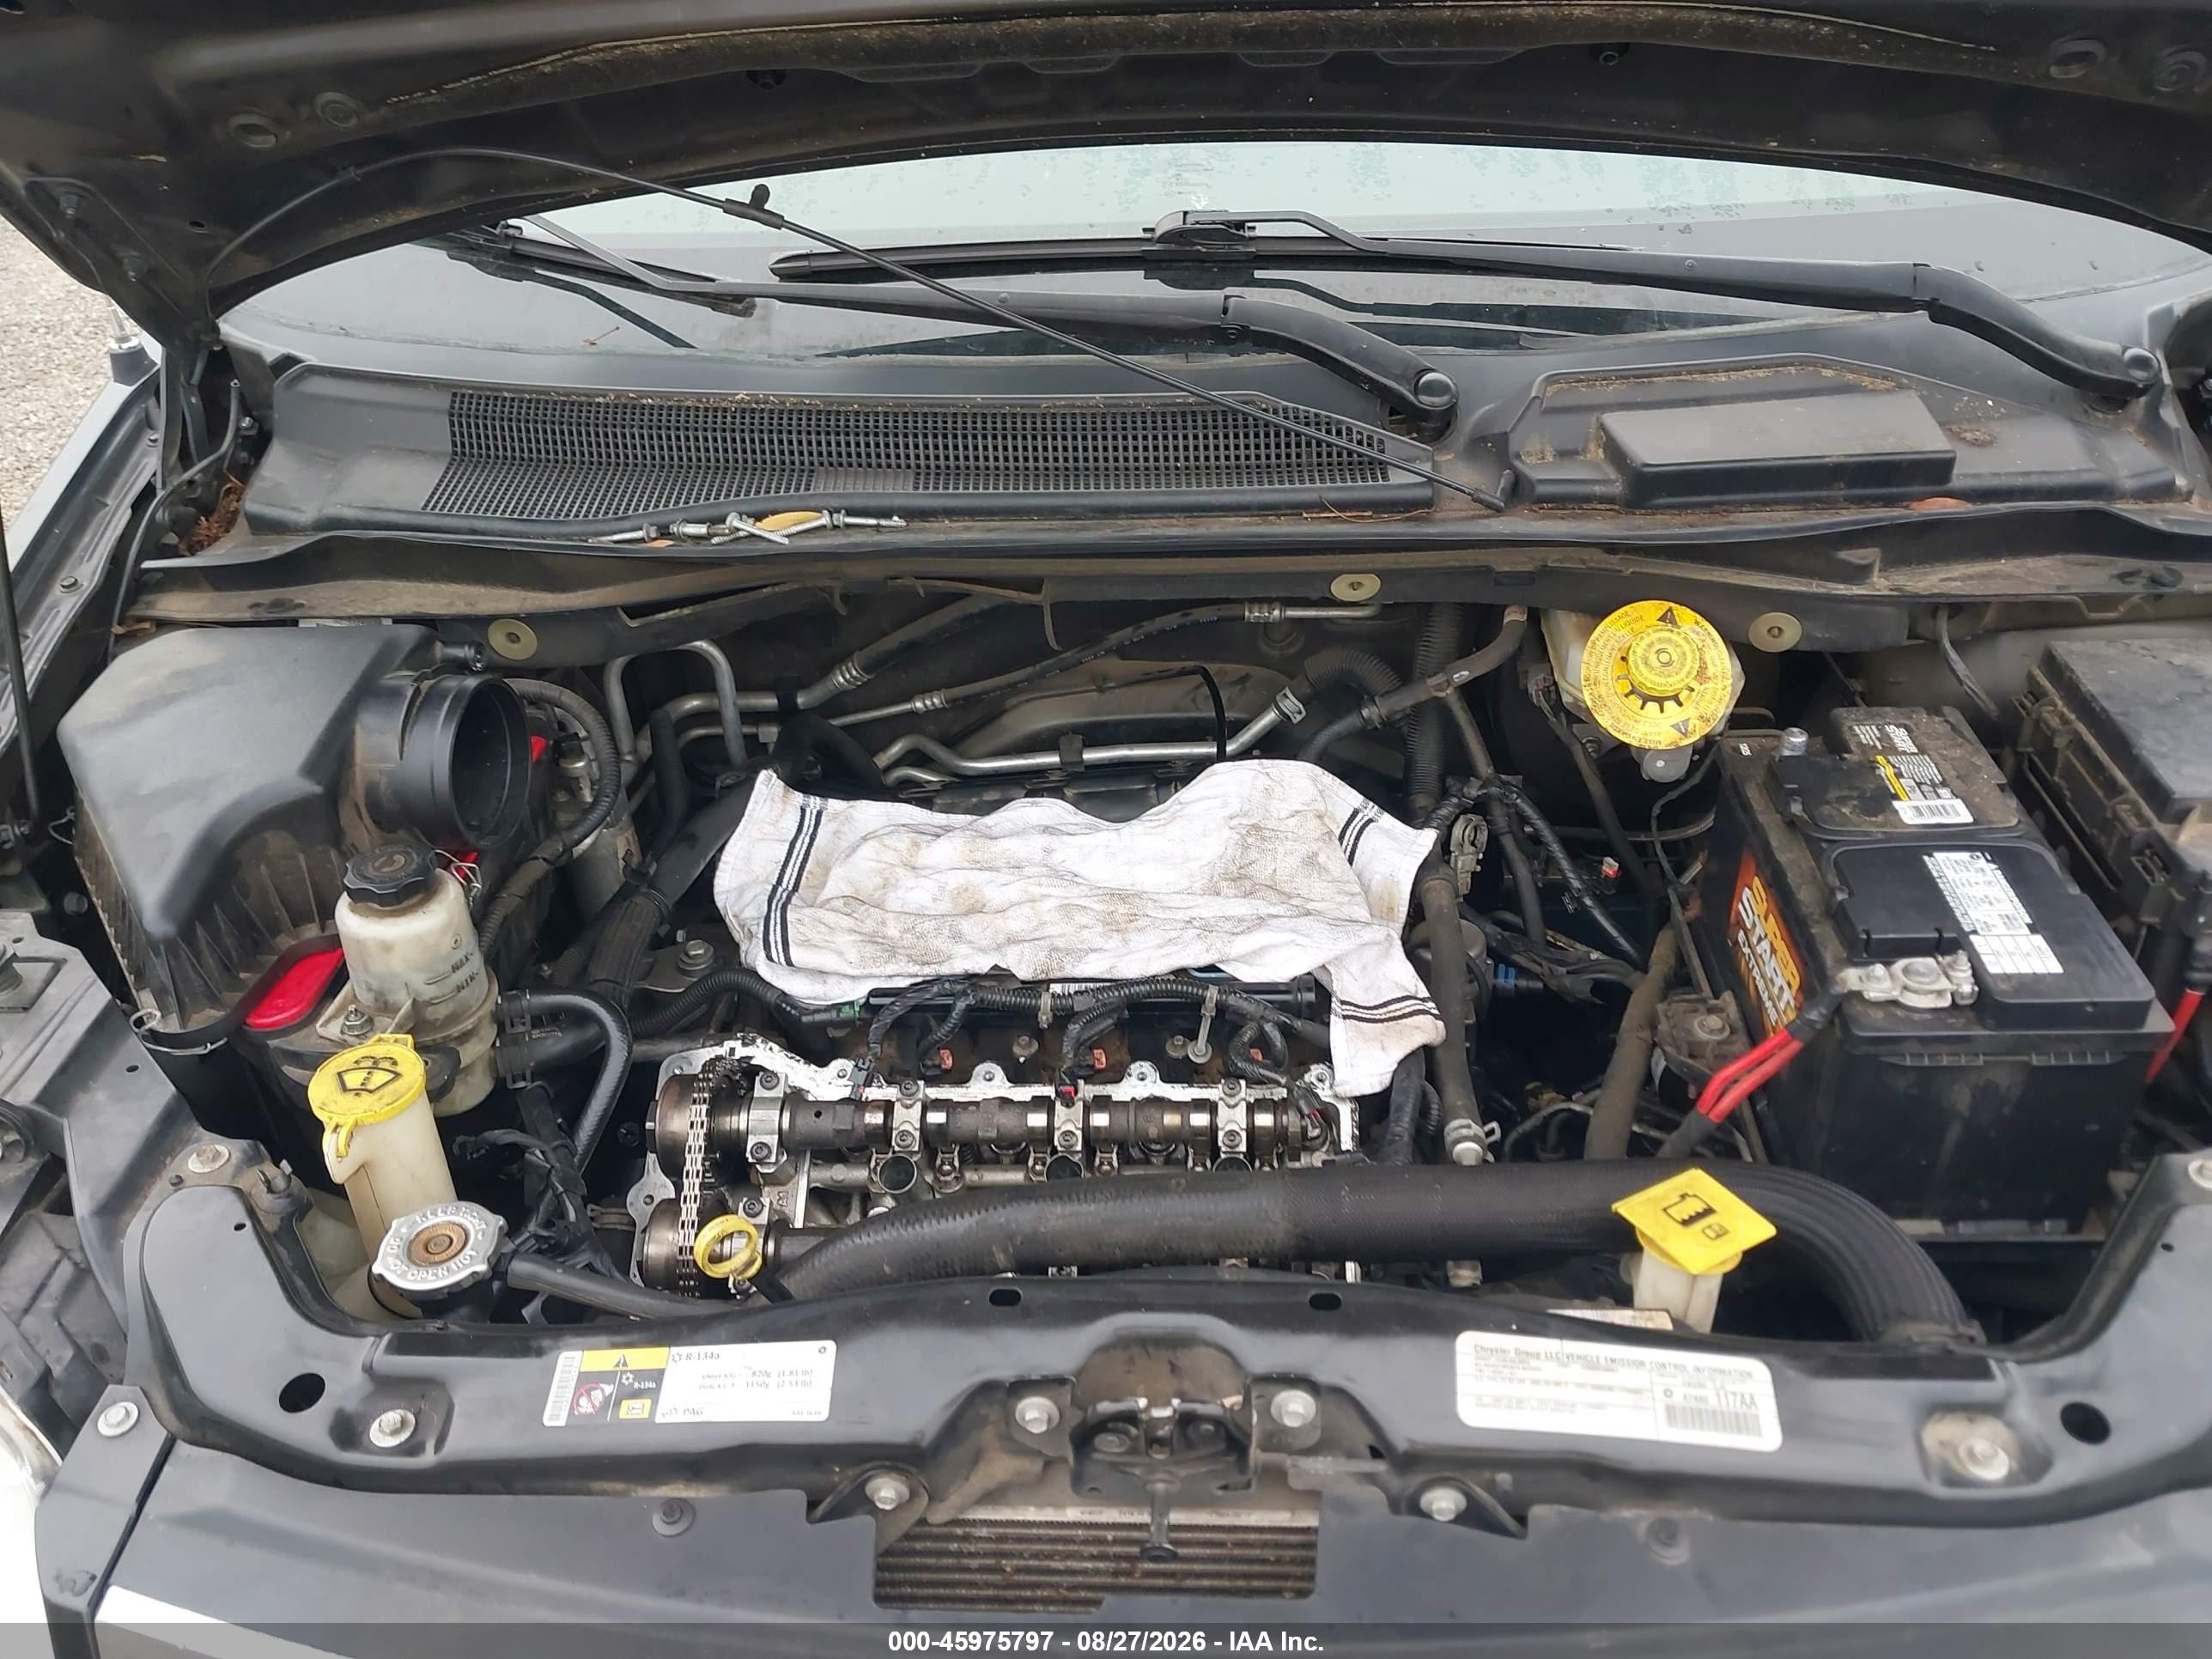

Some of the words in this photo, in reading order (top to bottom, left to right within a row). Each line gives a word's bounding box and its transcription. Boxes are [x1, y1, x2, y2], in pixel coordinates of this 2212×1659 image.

[1737, 928, 1778, 1027] EXTREME
[1738, 886, 1796, 1011] START
[1752, 875, 1800, 997] SUPER
[685, 1352, 720, 1363] R-134a
[1473, 1344, 1510, 1358] Chrysler
[1514, 1349, 1541, 1361] Group
[1544, 1351, 1561, 1361] LLC
[1565, 1352, 1601, 1364] VEHICLE
[1603, 1356, 1646, 1370] EMISSION
[1650, 1361, 1687, 1374] CONTROL
[1692, 1364, 1753, 1378] INFORMATION
